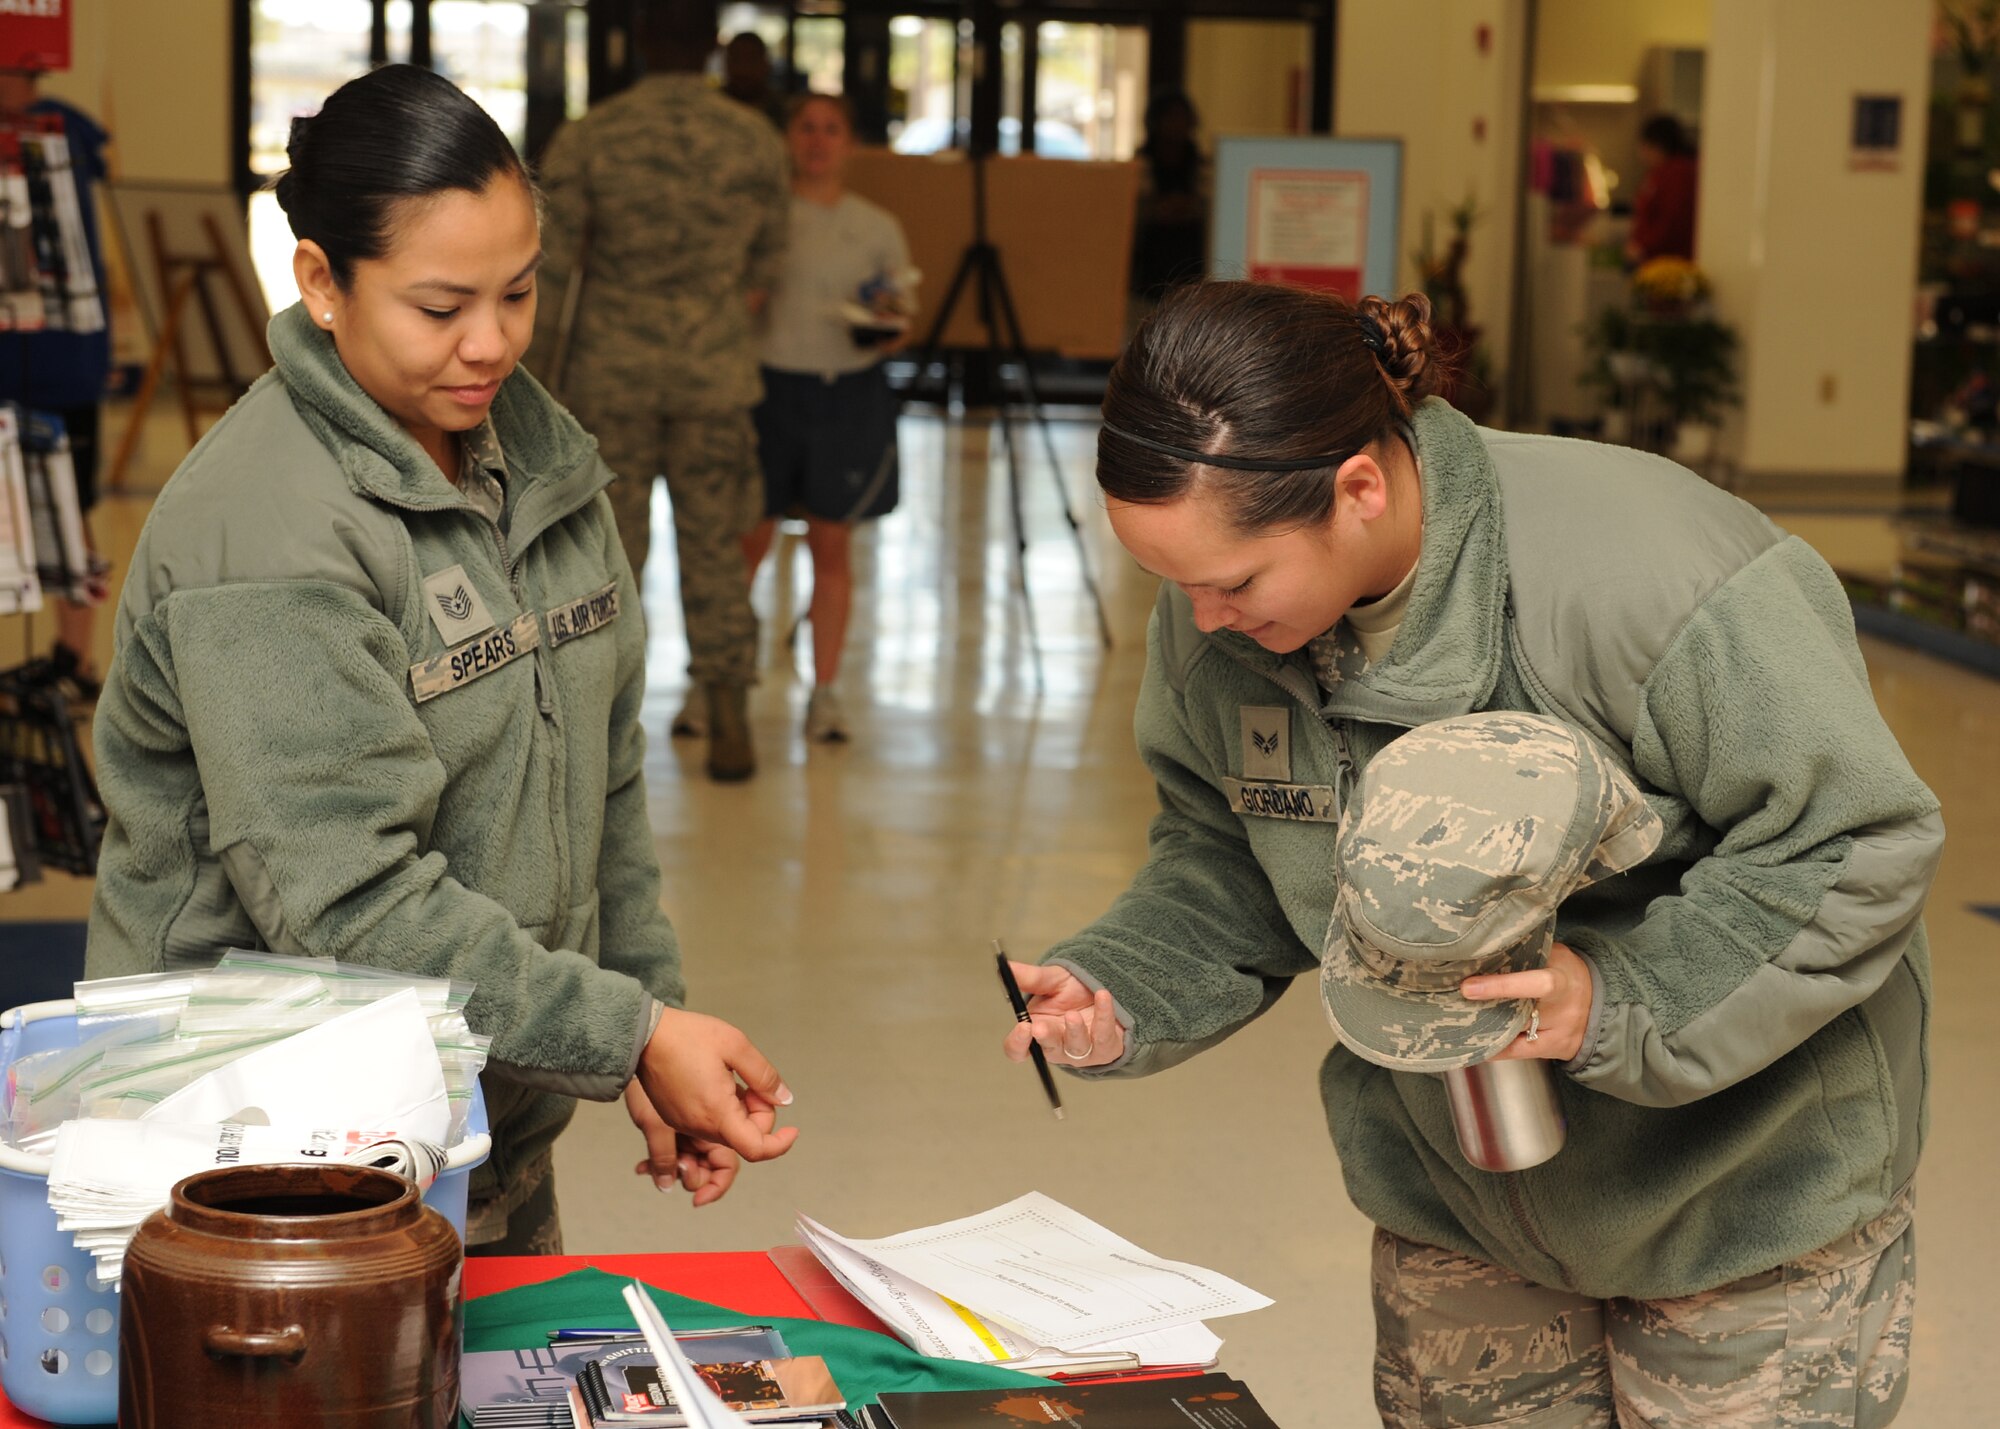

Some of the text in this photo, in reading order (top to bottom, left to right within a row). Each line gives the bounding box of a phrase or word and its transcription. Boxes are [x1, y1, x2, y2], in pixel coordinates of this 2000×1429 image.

[571, 604, 592, 634] AIR
[590, 590, 617, 626] FORCE
[451, 629, 516, 681] SPEARS
[1241, 787, 1314, 817] GIORDANO
[215, 1146, 240, 1164] YOU.
